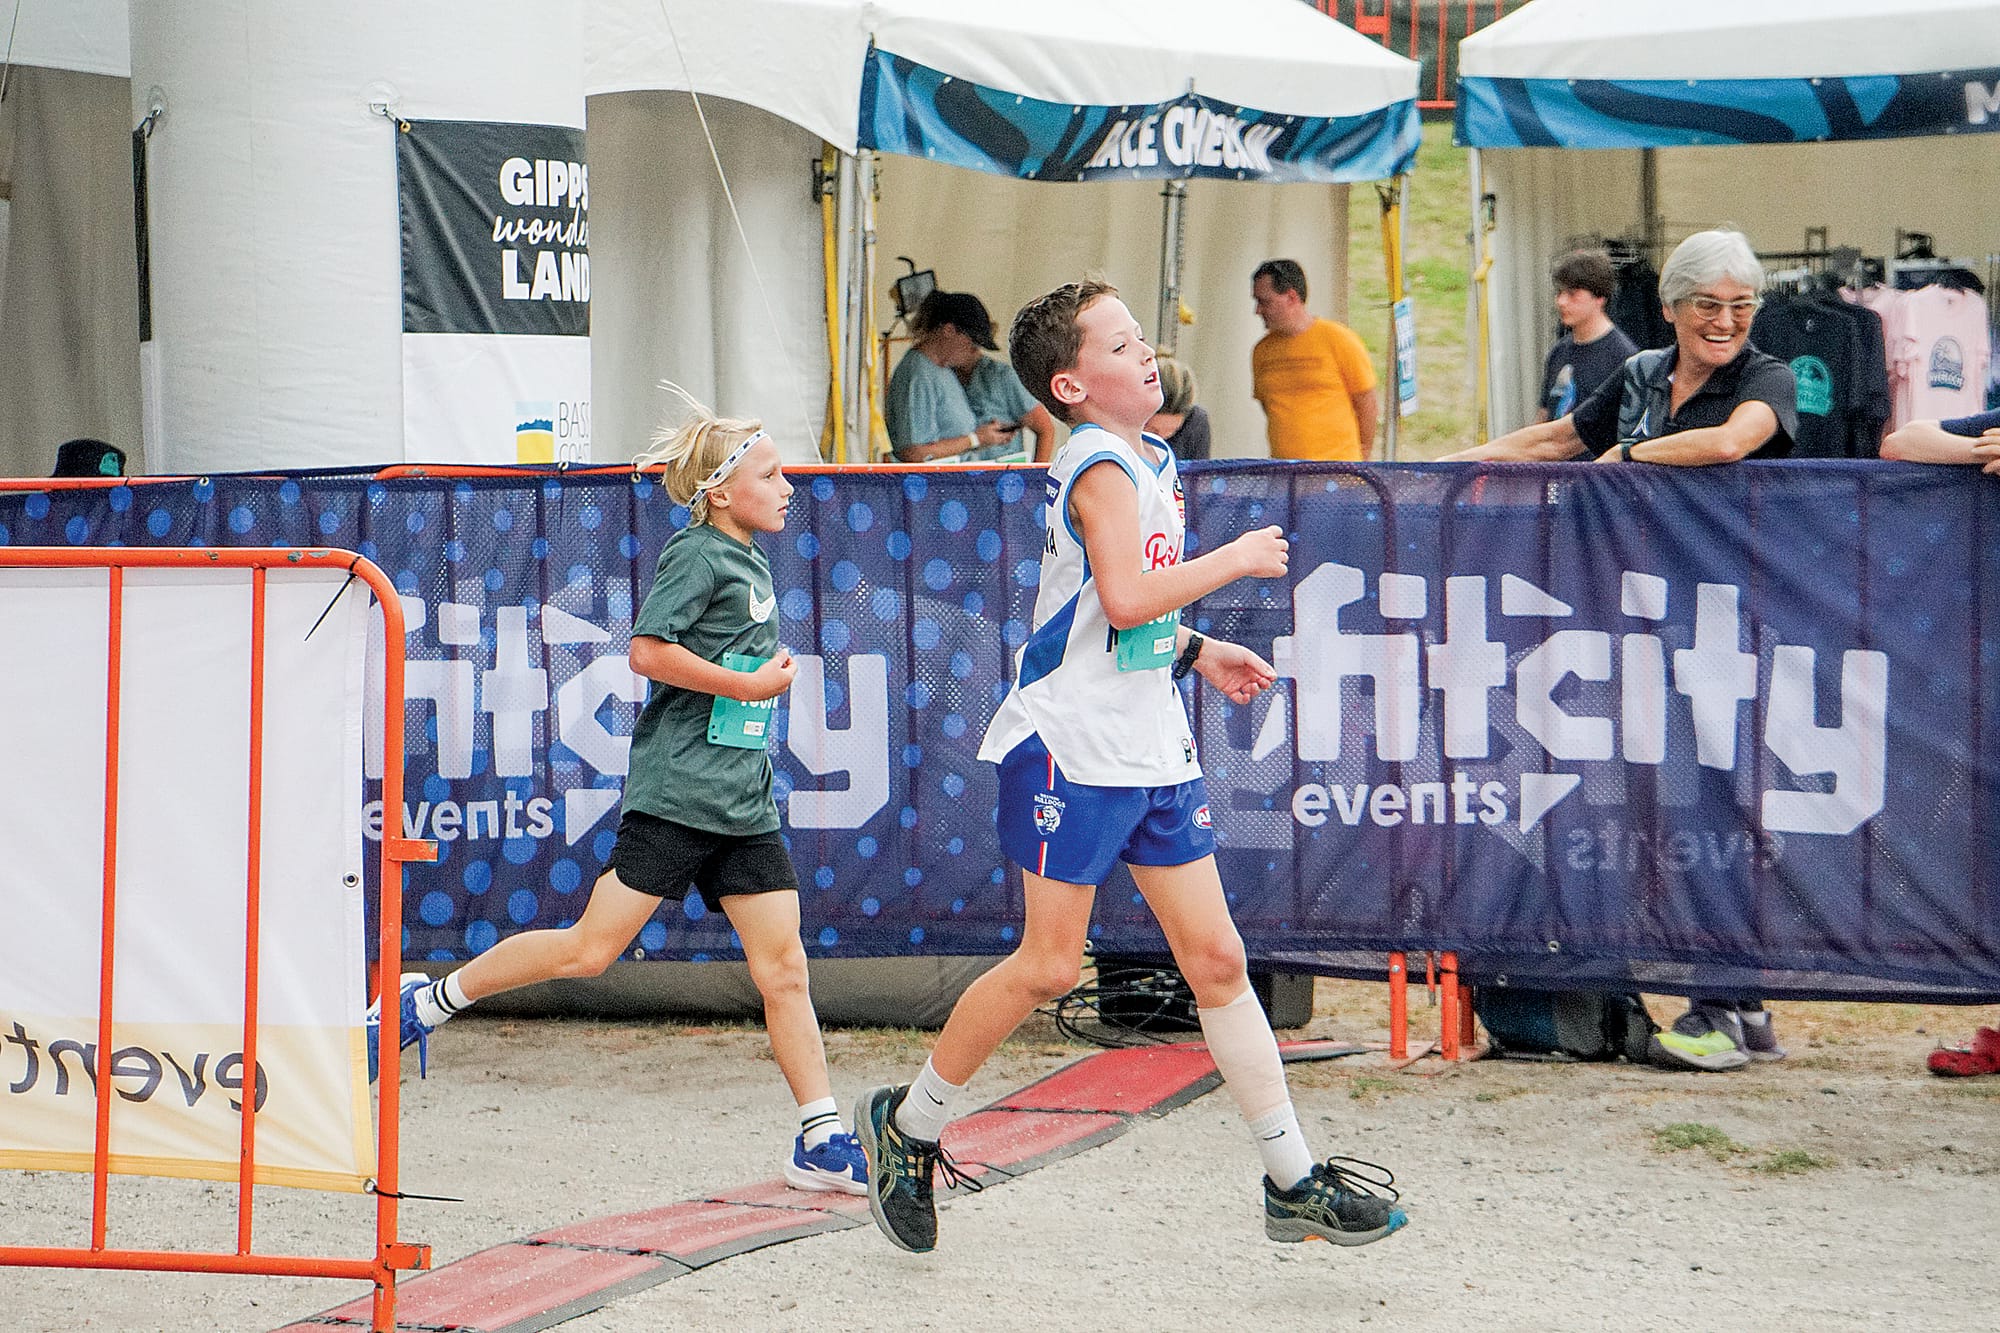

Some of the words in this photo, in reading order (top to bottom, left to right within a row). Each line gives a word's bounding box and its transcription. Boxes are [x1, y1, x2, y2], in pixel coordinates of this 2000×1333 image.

[502, 249, 591, 303] LAND
[1273, 562, 1888, 835] fitcity
[362, 791, 554, 841] events
[1291, 771, 1507, 828] events
